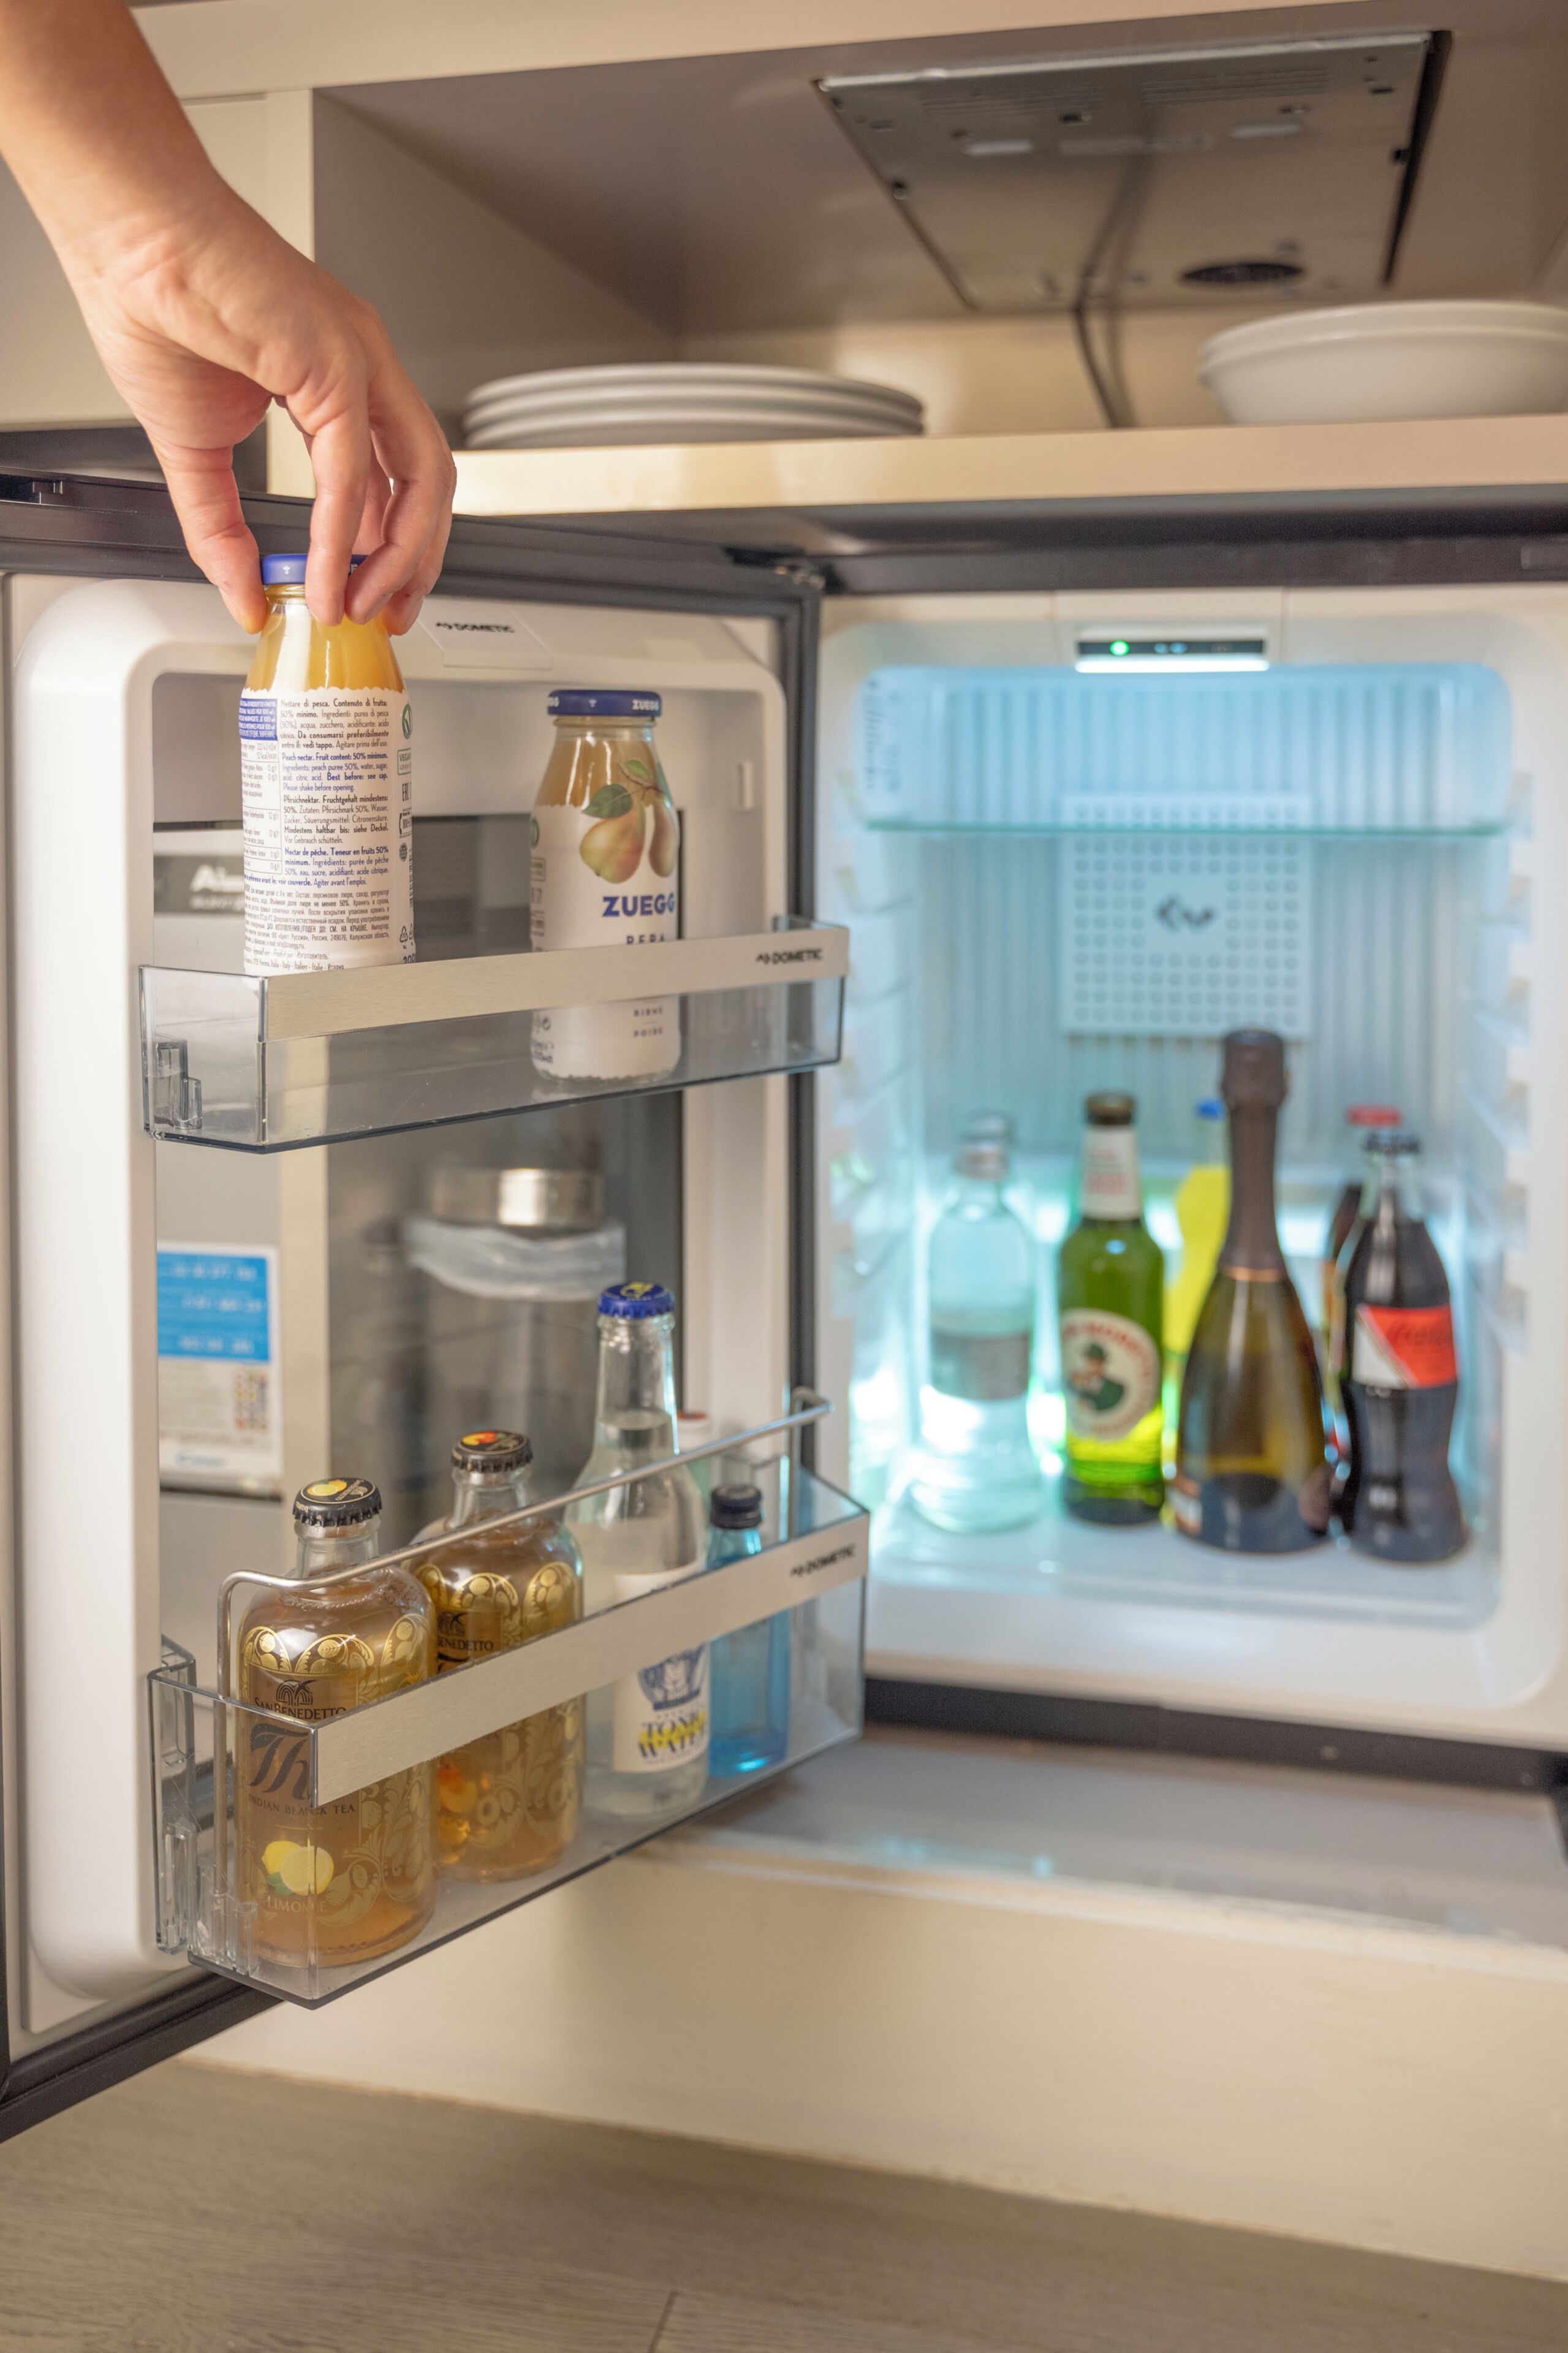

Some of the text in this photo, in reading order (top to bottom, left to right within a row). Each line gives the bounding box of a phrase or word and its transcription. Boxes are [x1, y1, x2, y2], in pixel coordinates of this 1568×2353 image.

[304, 698, 309, 707] di
[366, 697, 371, 706] di
[373, 697, 388, 707] frutta:
[322, 708, 351, 720] Ingredienti:
[370, 708, 375, 717] di
[319, 719, 344, 729] zucchero,
[378, 718, 389, 727] acido
[347, 729, 388, 740] preferibilmente
[316, 741, 334, 751] tappo.
[336, 740, 355, 751] Agitare
[356, 741, 369, 749] prima
[316, 752, 329, 760] Fruit
[282, 762, 310, 773] Ingredients:
[311, 762, 327, 773] peach
[312, 772, 323, 781] acid.
[327, 772, 340, 781] Best
[344, 771, 364, 780] before:
[314, 782, 331, 791] before
[333, 784, 355, 793] opening.
[323, 794, 358, 805] Fruchtgehalt
[360, 793, 388, 802] mindestens:
[299, 805, 320, 814] Zutaten:
[322, 805, 354, 814] Pfirsichmark
[284, 814, 388, 825] Zucker, Säuerungsmittel: Citronensäure.
[284, 822, 388, 833] Mindestens haltbar bis: siehe Deckel.
[284, 835, 293, 843] Vor
[294, 835, 317, 844] Gebrauch
[318, 835, 343, 844] schütteln.
[285, 847, 301, 855] Nectar
[303, 847, 309, 855] de
[330, 847, 351, 855] Teneur
[362, 846, 374, 855] fruits
[313, 857, 347, 868] Ingrédients:
[349, 858, 365, 868] purée
[366, 855, 373, 865] de
[329, 866, 355, 876] acidifiant:
[357, 866, 369, 875] acide
[371, 866, 388, 876] citrique.
[288, 877, 312, 886] couvercle.
[314, 878, 329, 889] Agiter
[346, 876, 366, 887] l'emploi.
[602, 892, 675, 917] ZUEGG
[249, 1793, 280, 1813] INDIAN
[334, 1803, 356, 1814] TEA
